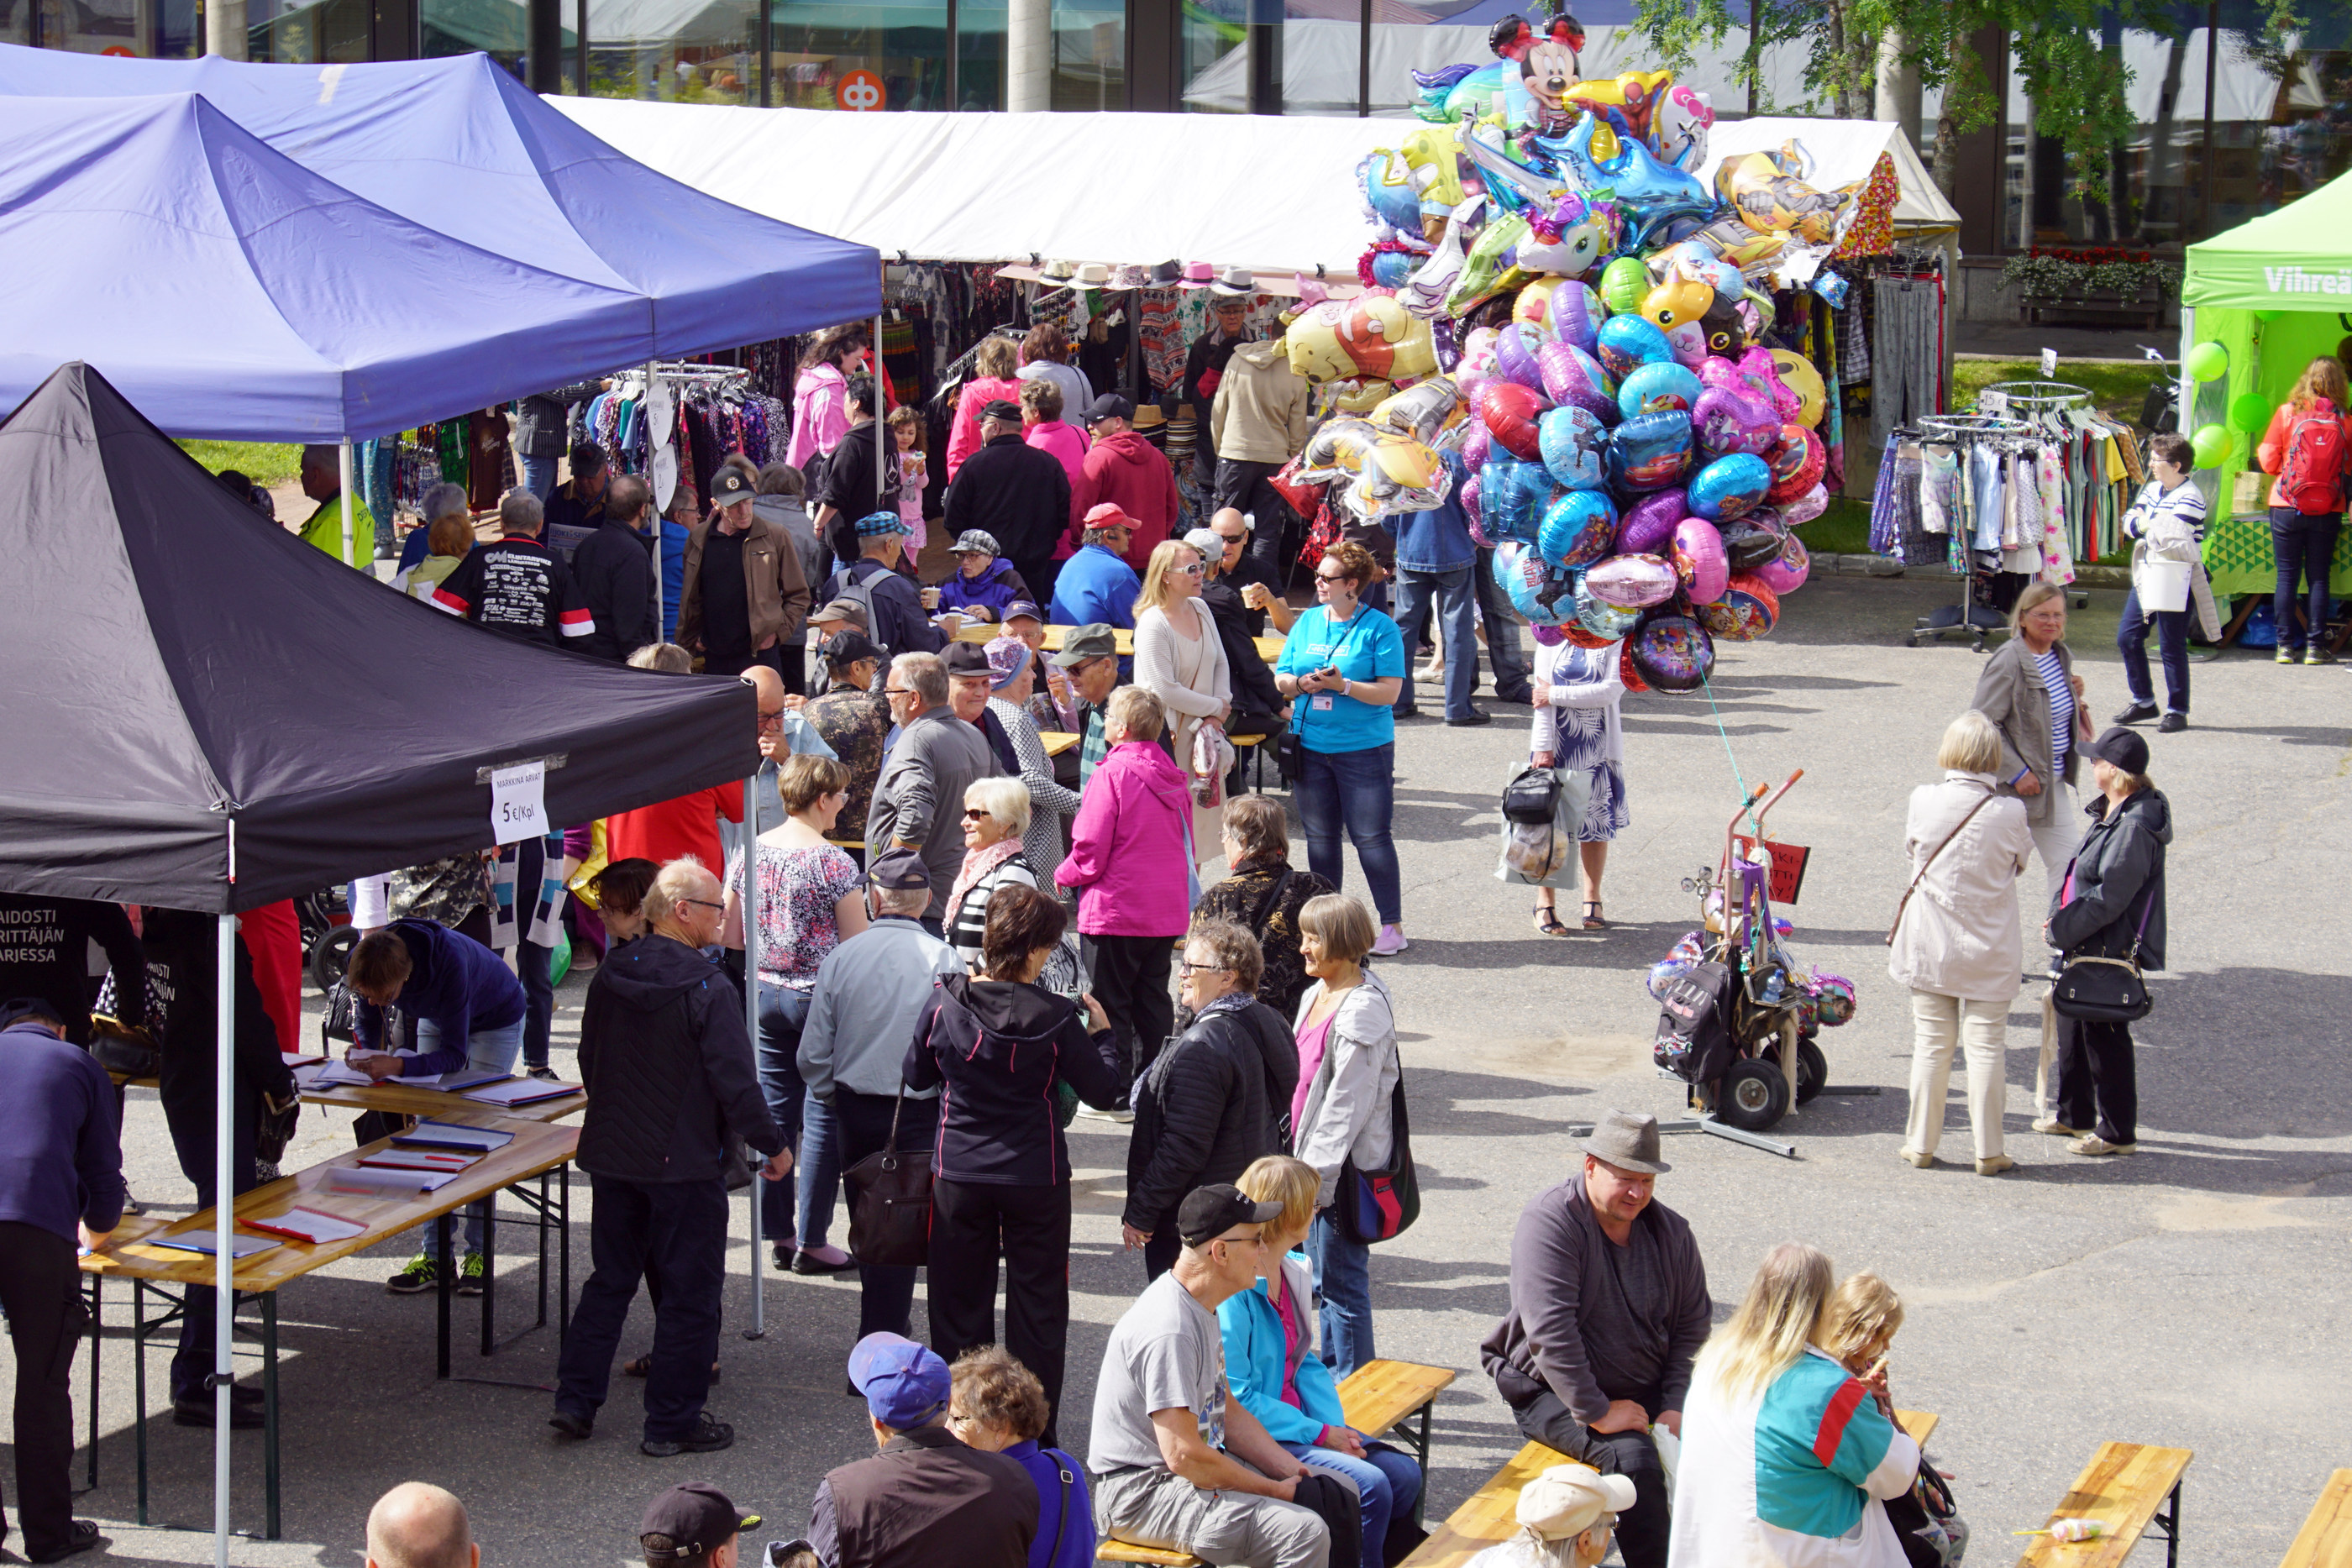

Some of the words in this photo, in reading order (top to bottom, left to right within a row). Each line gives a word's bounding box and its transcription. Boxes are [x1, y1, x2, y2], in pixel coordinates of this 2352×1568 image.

[2263, 265, 2352, 295] Vihreä
[496, 776, 524, 789] MARKKINA
[525, 773, 541, 783] ARVAT
[503, 801, 510, 822] 5
